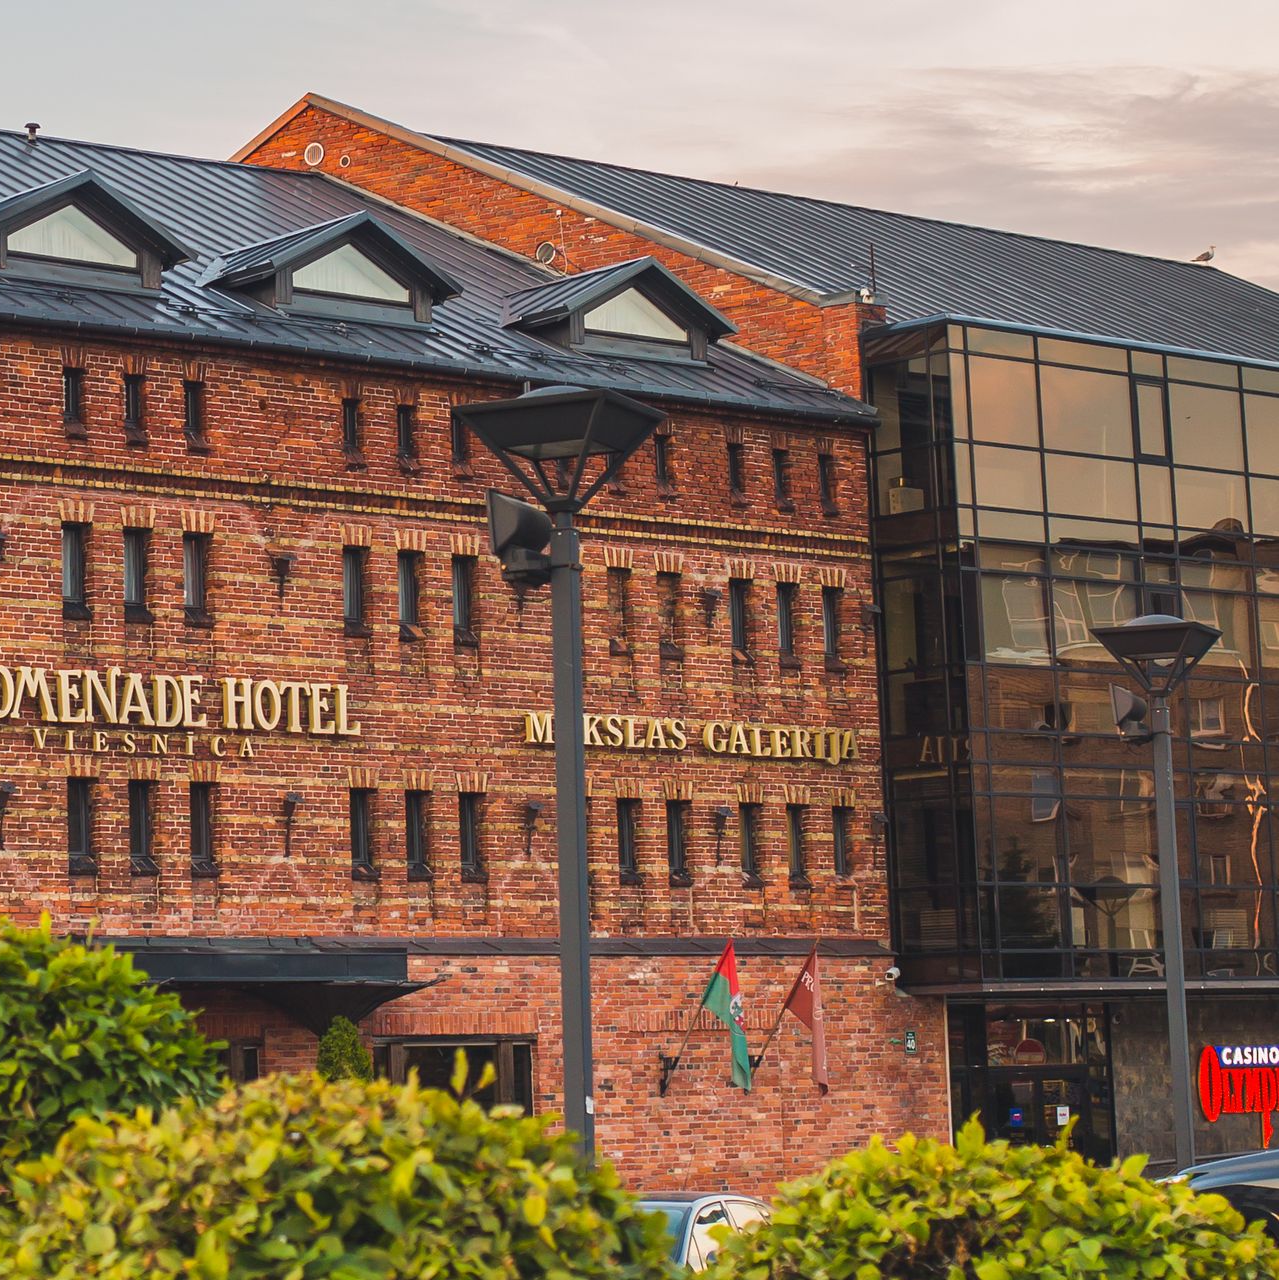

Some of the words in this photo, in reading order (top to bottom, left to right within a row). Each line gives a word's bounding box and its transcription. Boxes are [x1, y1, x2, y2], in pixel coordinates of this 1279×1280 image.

[221, 677, 362, 736] HOTEL
[33, 728, 255, 758] VIESNĪCA
[523, 712, 688, 751] MKSLAS
[703, 721, 861, 766] GALERIJA
[906, 1039, 916, 1050] 40
[1221, 1046, 1279, 1066] CASINO
